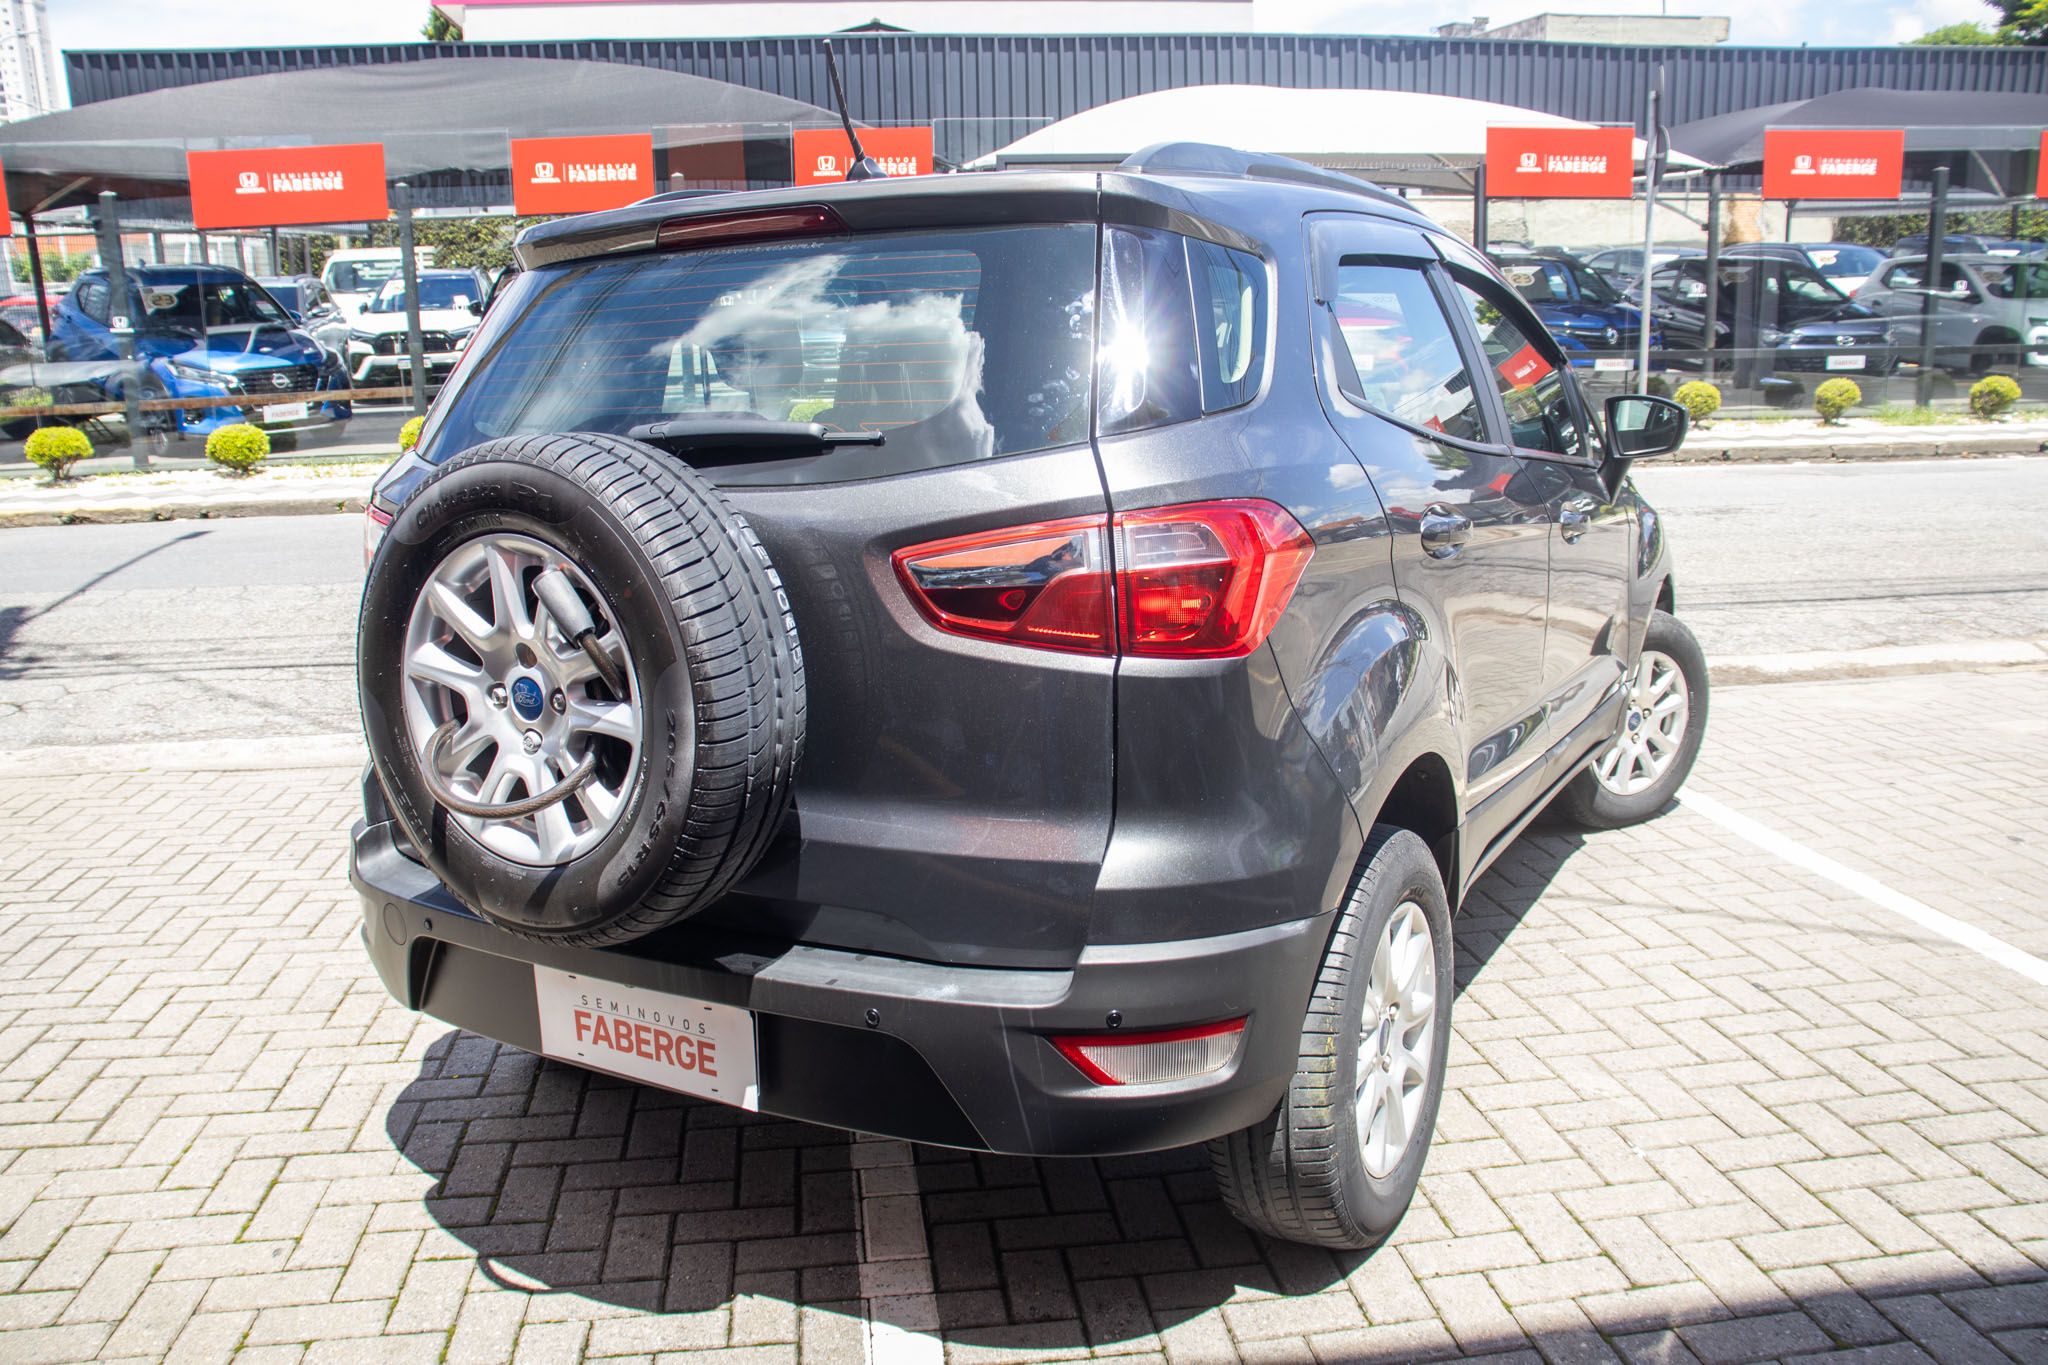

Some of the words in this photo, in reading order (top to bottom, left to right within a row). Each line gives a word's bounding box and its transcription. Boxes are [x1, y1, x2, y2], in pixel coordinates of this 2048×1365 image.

[1548, 160, 1607, 173] FABERGE
[1820, 163, 1877, 175] FABERGE
[568, 167, 637, 182] FABERGE
[272, 177, 344, 192] FABERGE
[518, 694, 536, 705] Ford
[581, 994, 706, 1034] SEMINOVOS
[574, 1009, 718, 1077] FABERGE
